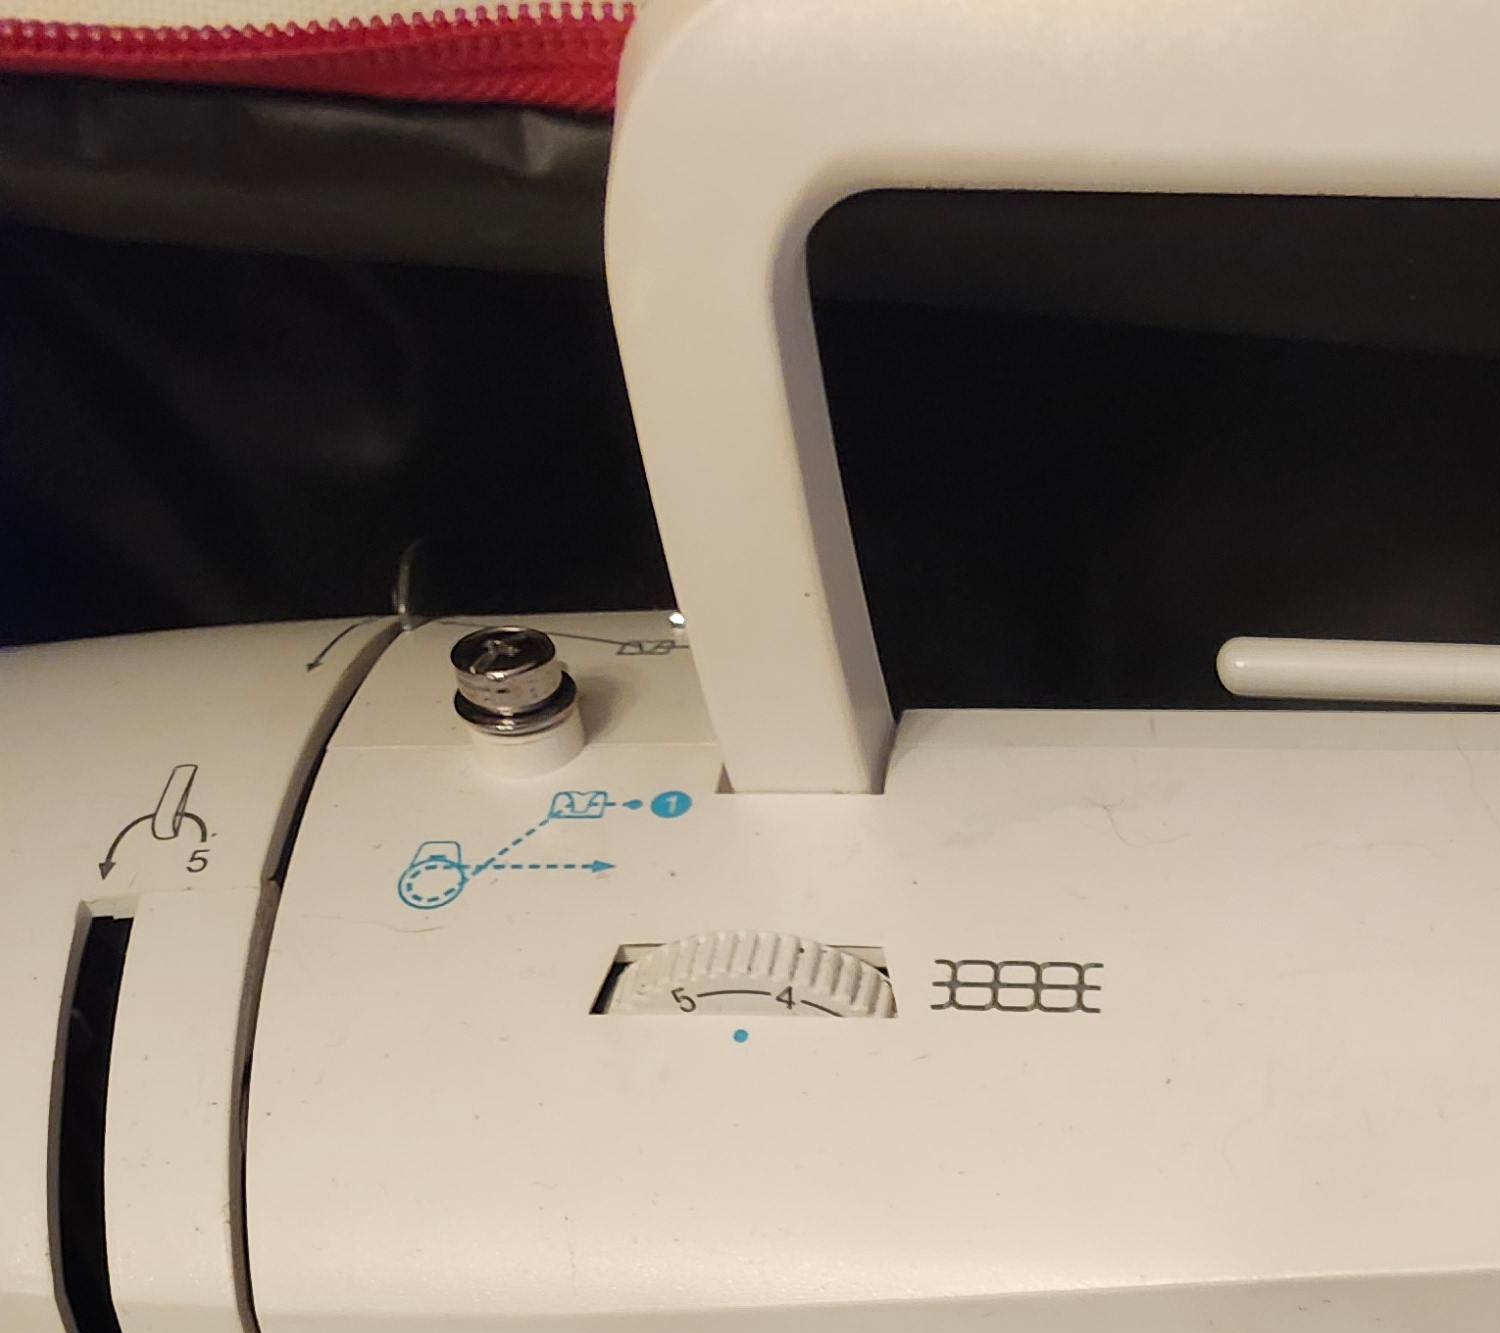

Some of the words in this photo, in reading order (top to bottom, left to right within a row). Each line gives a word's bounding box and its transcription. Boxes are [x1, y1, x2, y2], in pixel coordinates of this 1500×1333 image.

[186, 849, 211, 873] 5
[671, 986, 698, 1014] 5
[773, 986, 796, 1010] 4
